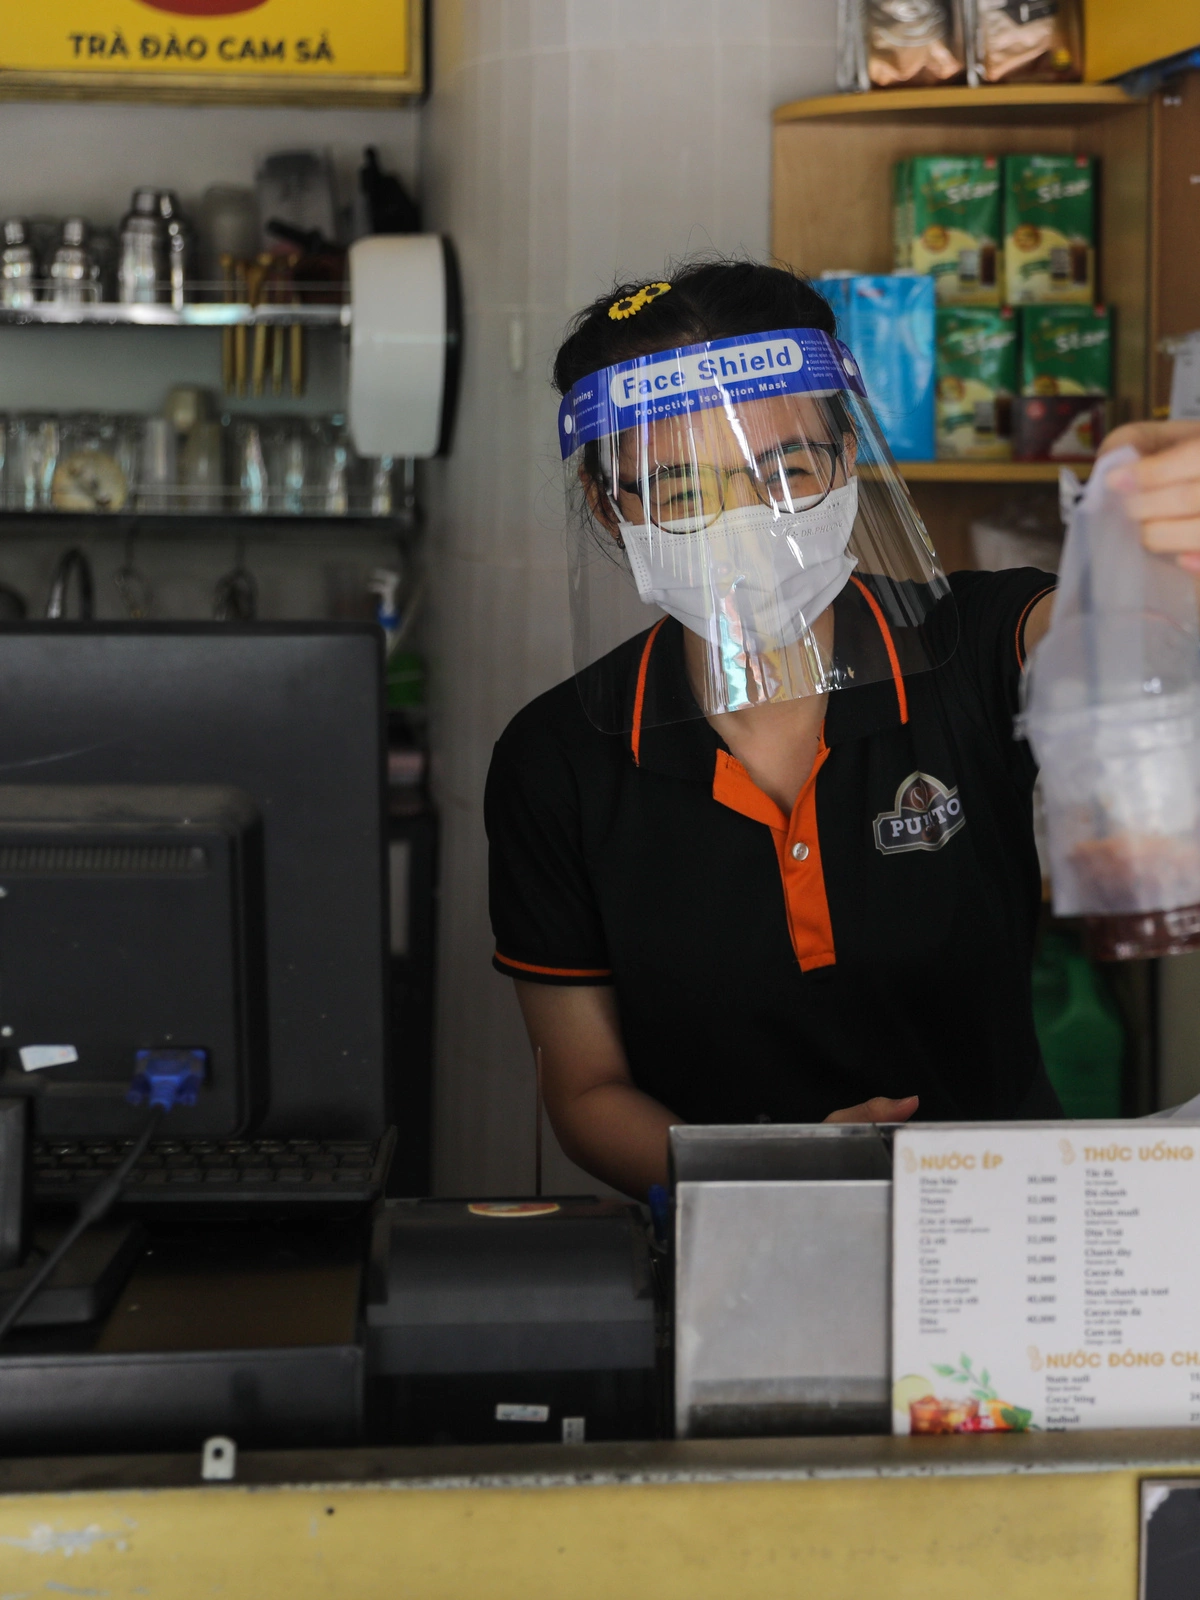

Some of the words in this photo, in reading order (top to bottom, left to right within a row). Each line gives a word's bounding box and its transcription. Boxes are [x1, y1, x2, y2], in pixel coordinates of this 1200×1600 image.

[69, 27, 129, 58] TRÀ
[139, 28, 208, 61] ĐÀO
[217, 37, 286, 62] CAM
[622, 368, 686, 399] Face
[697, 346, 792, 382] Shield
[635, 398, 695, 418] Protective
[700, 386, 754, 403] Isoltion
[758, 380, 788, 392] Mask
[982, 1152, 1003, 1169] ÉP
